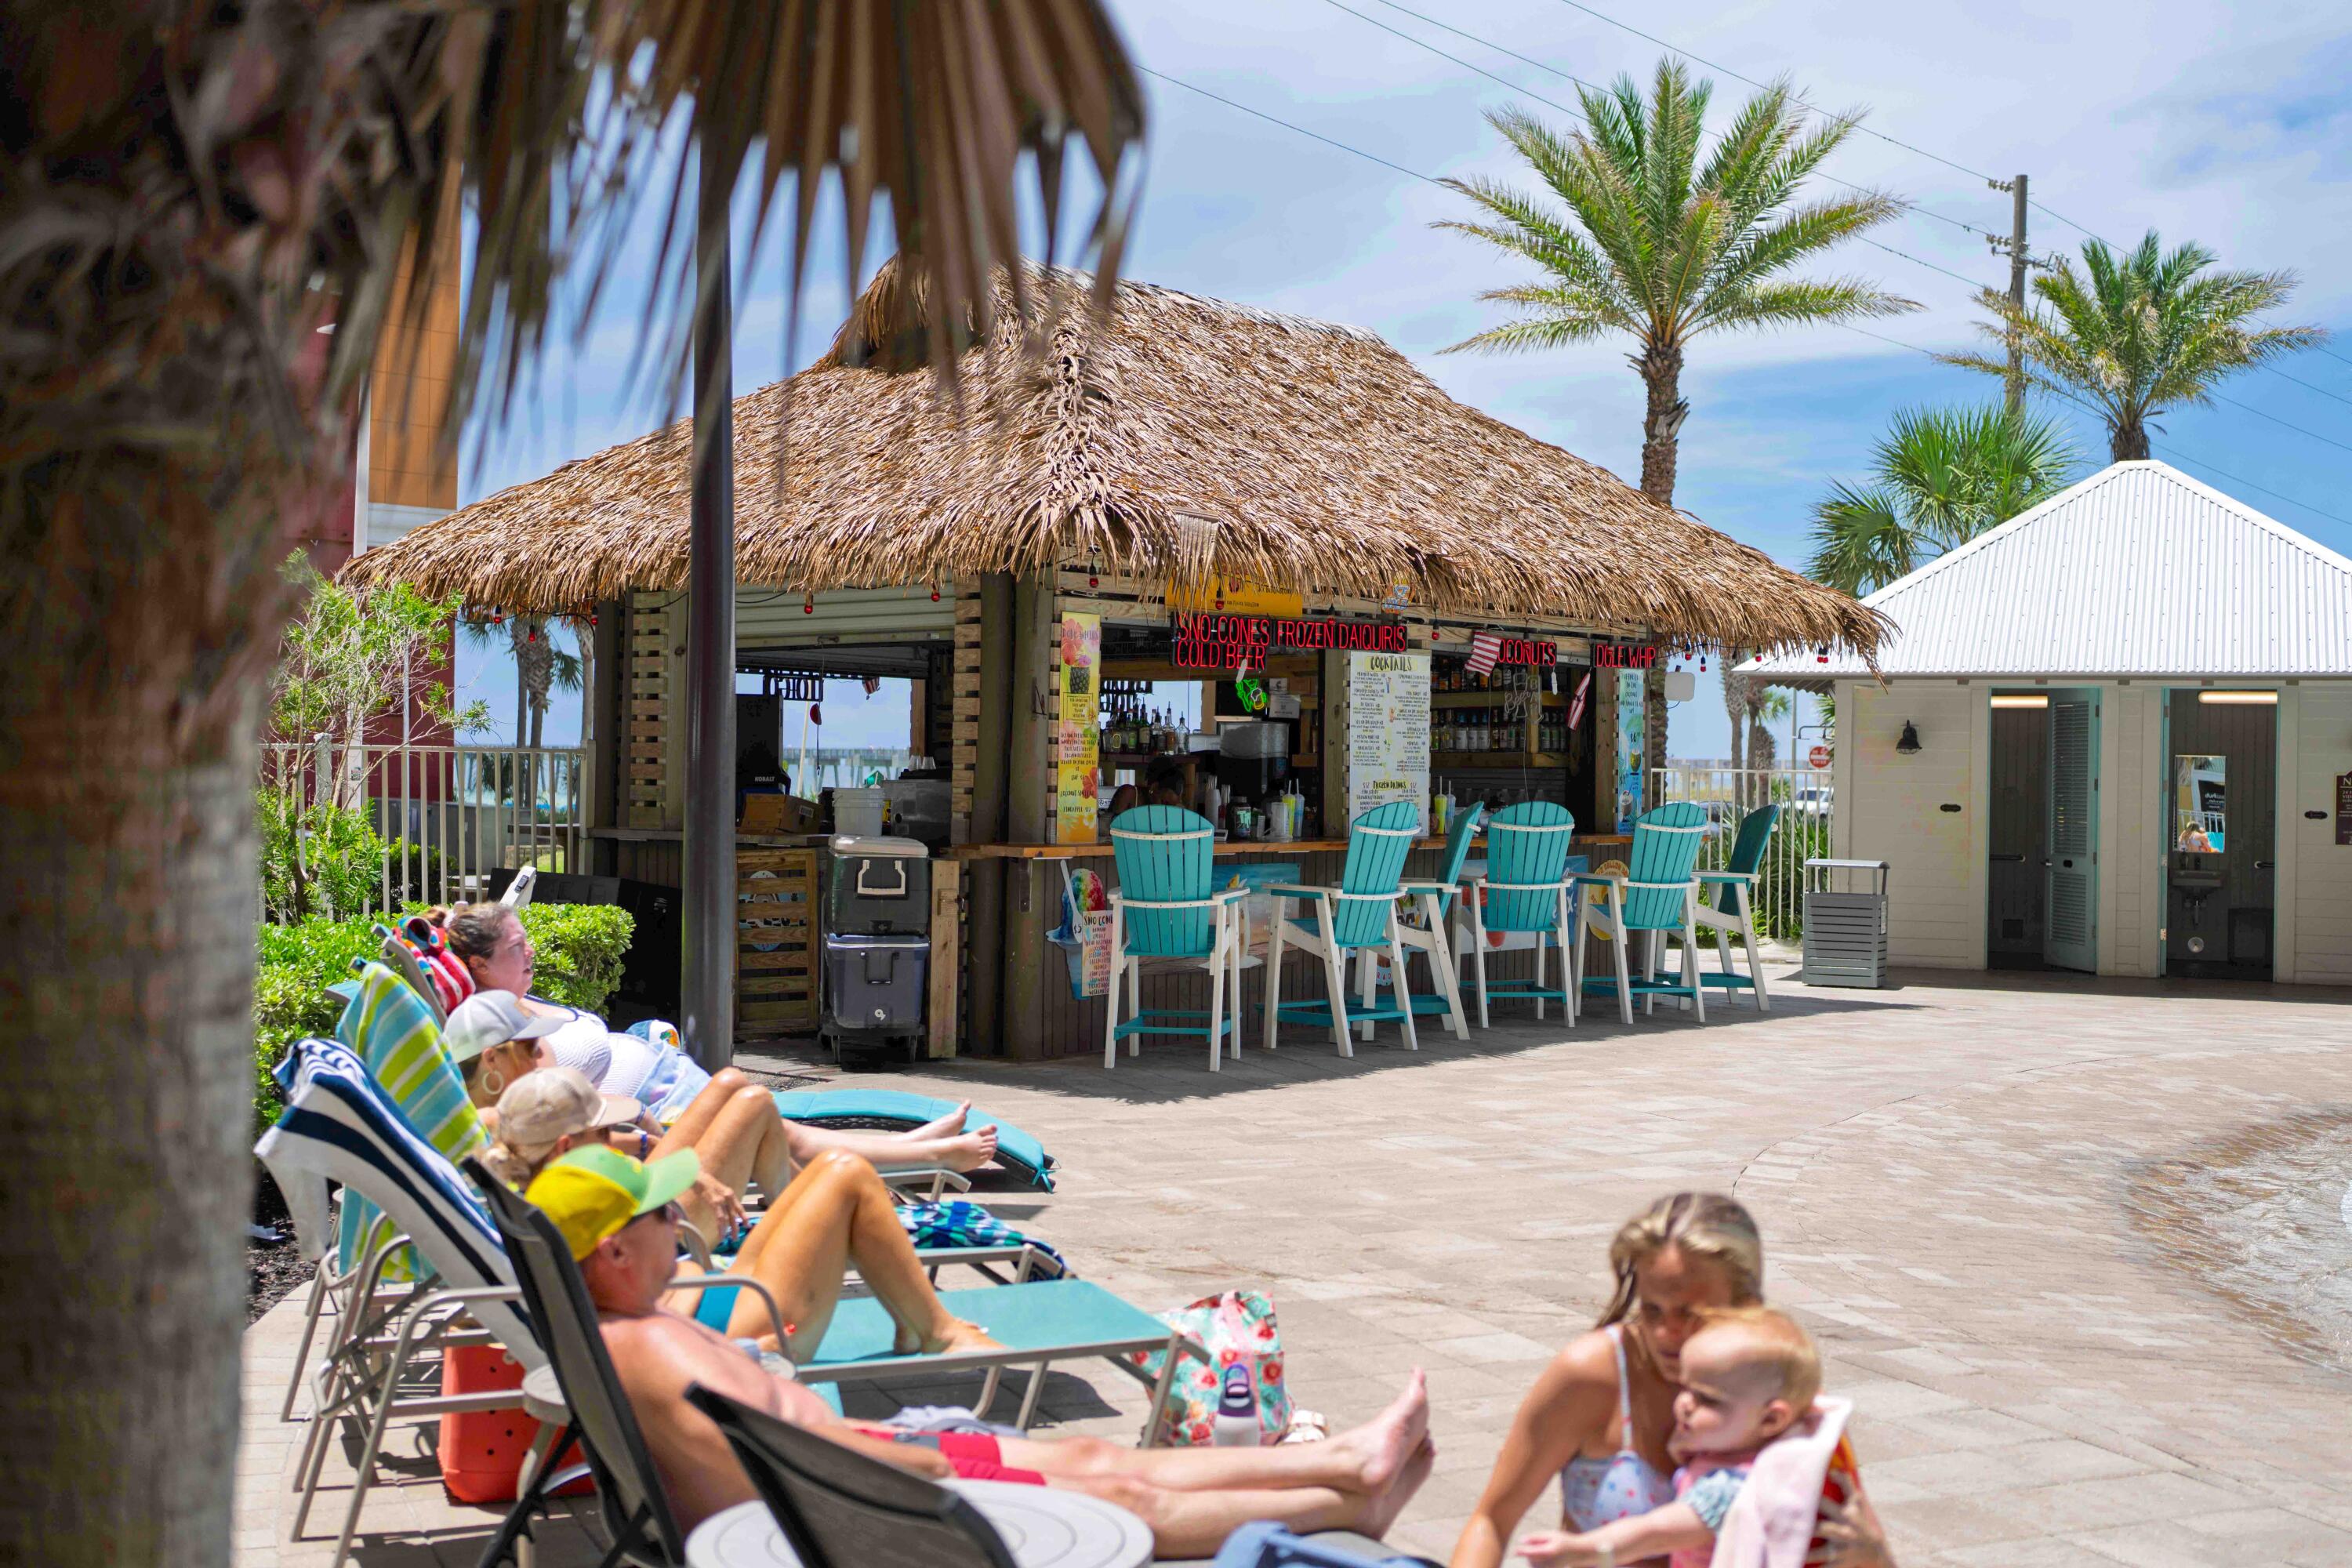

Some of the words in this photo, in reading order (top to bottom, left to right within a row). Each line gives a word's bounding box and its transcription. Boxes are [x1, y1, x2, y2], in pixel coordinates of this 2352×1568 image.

[1178, 613, 1211, 642] SNO
[1218, 616, 1270, 646] CONES
[1277, 620, 1333, 649] FROZEN
[1338, 623, 1406, 652] DAIQUIRIS
[1177, 641, 1221, 667] COLD
[1225, 644, 1265, 670] BEER
[1370, 655, 1412, 671] COCKTAILS
[1497, 639, 1556, 666] OCONUTS
[1596, 644, 1625, 668] DOLE
[1628, 646, 1657, 669] WHIP
[1391, 780, 1406, 789] DRINKS
[1083, 916, 1097, 925] SNO
